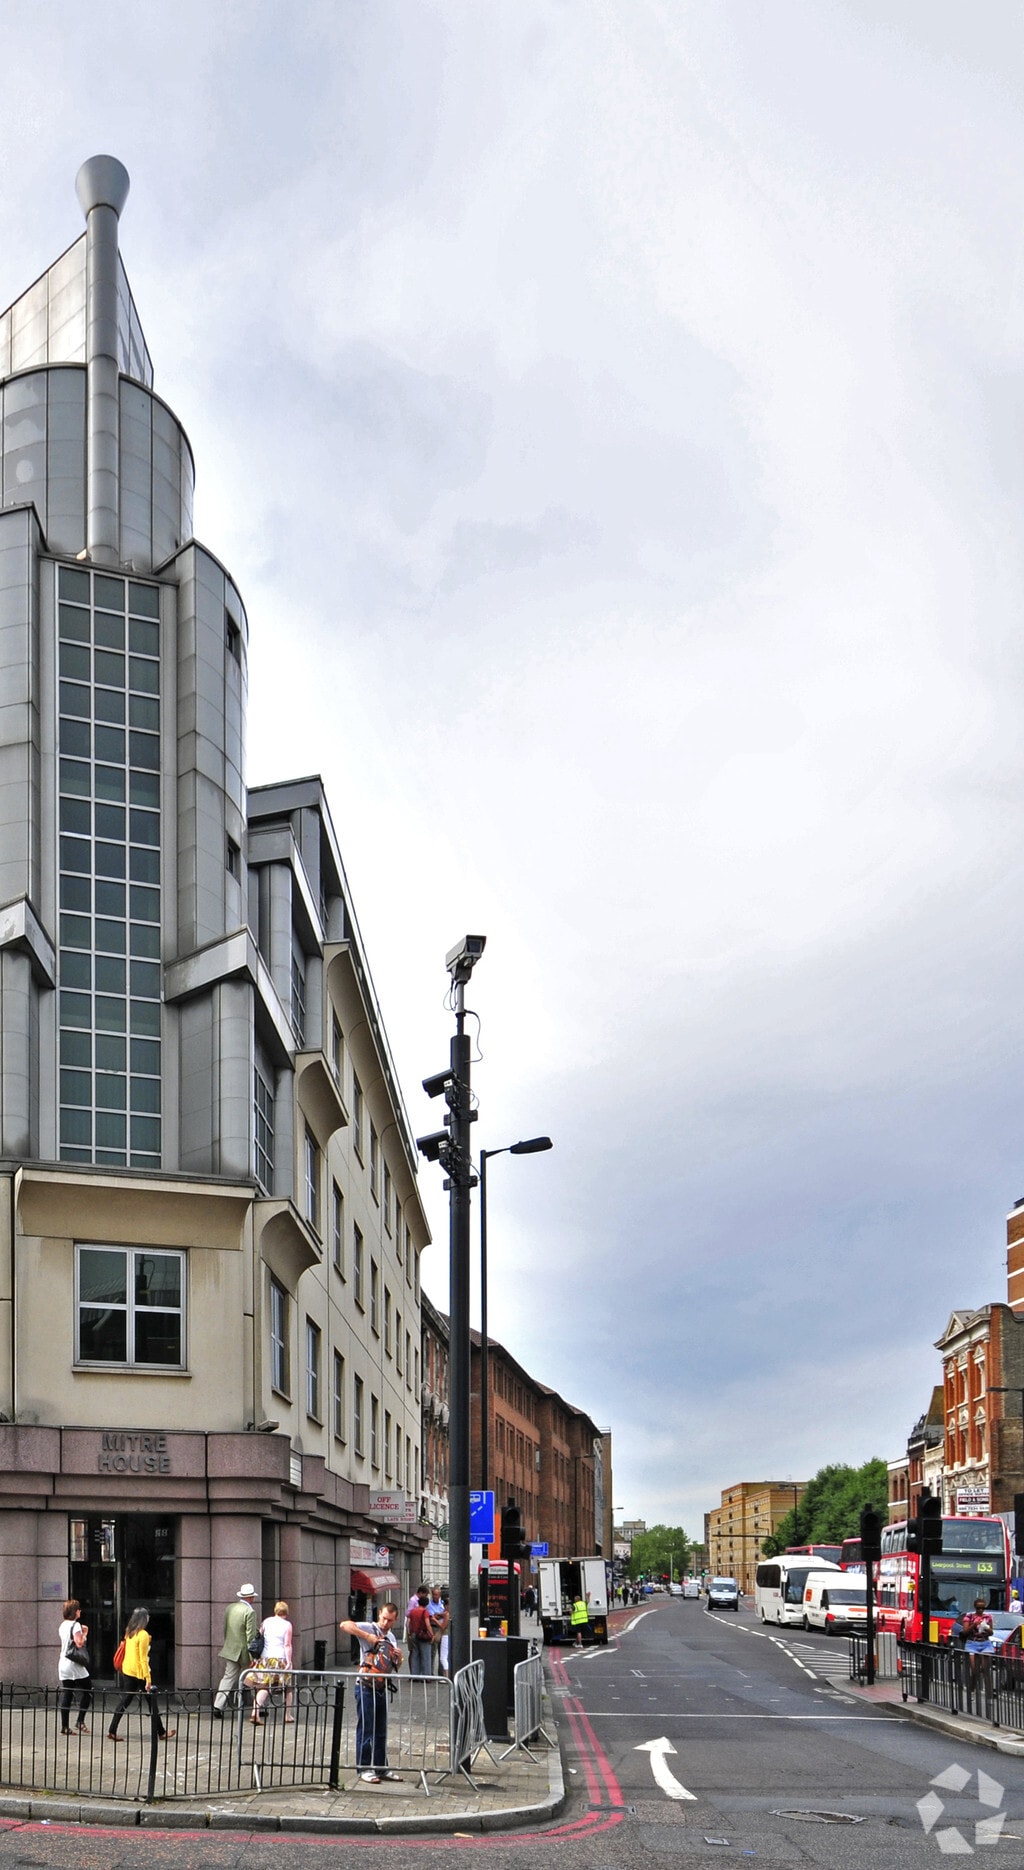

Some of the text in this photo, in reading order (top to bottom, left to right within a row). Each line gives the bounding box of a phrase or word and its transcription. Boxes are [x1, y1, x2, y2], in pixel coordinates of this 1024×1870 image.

[102, 1433, 167, 1453] MITRE
[98, 1454, 171, 1473] HOUSE
[977, 1562, 993, 1572] 133
